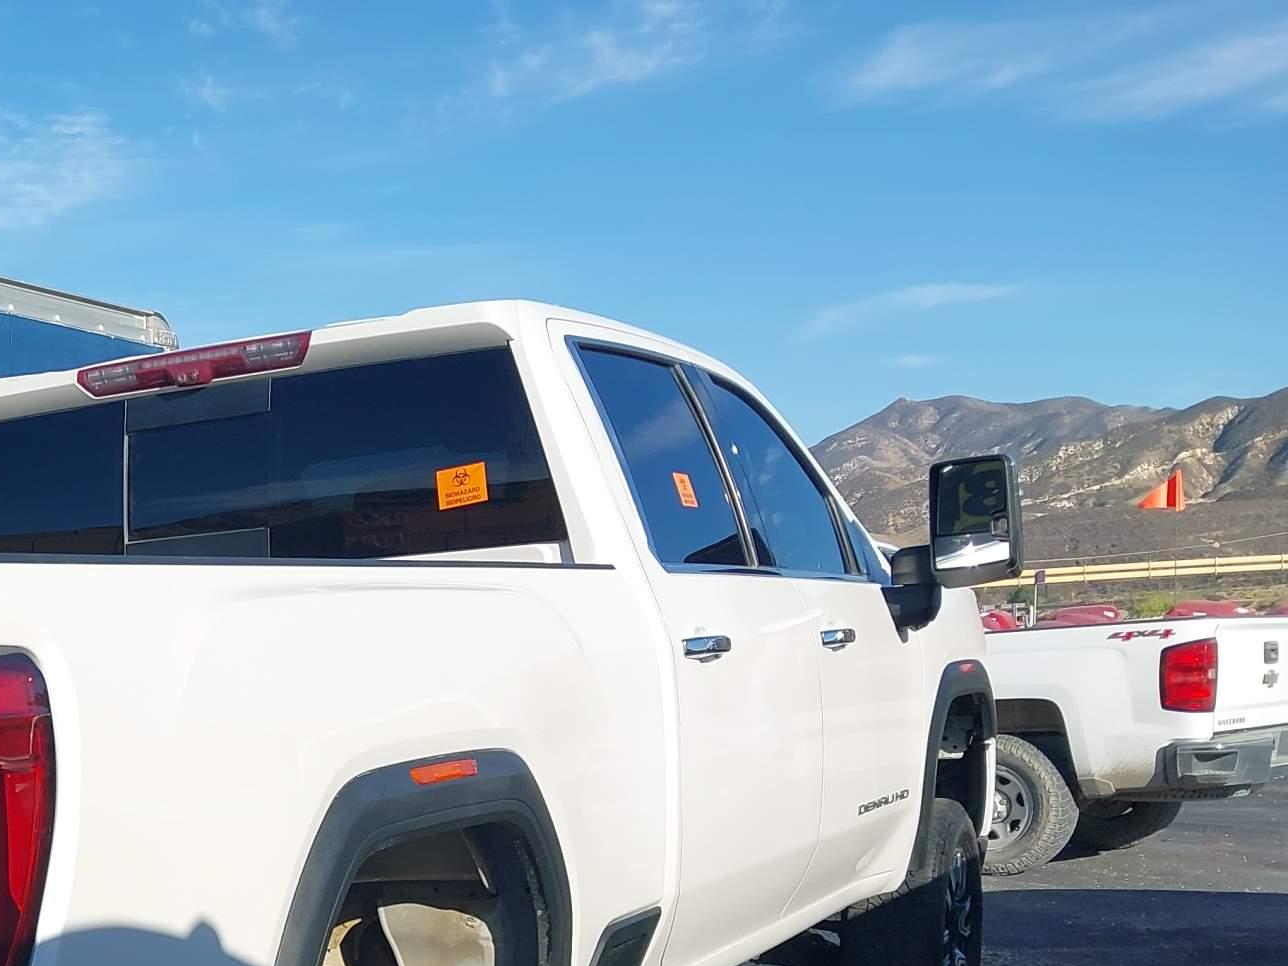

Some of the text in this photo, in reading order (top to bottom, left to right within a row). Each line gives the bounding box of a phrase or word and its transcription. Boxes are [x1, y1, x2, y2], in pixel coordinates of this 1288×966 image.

[445, 486, 481, 499] BIOHAZARD
[857, 788, 910, 816] DENALI HD
